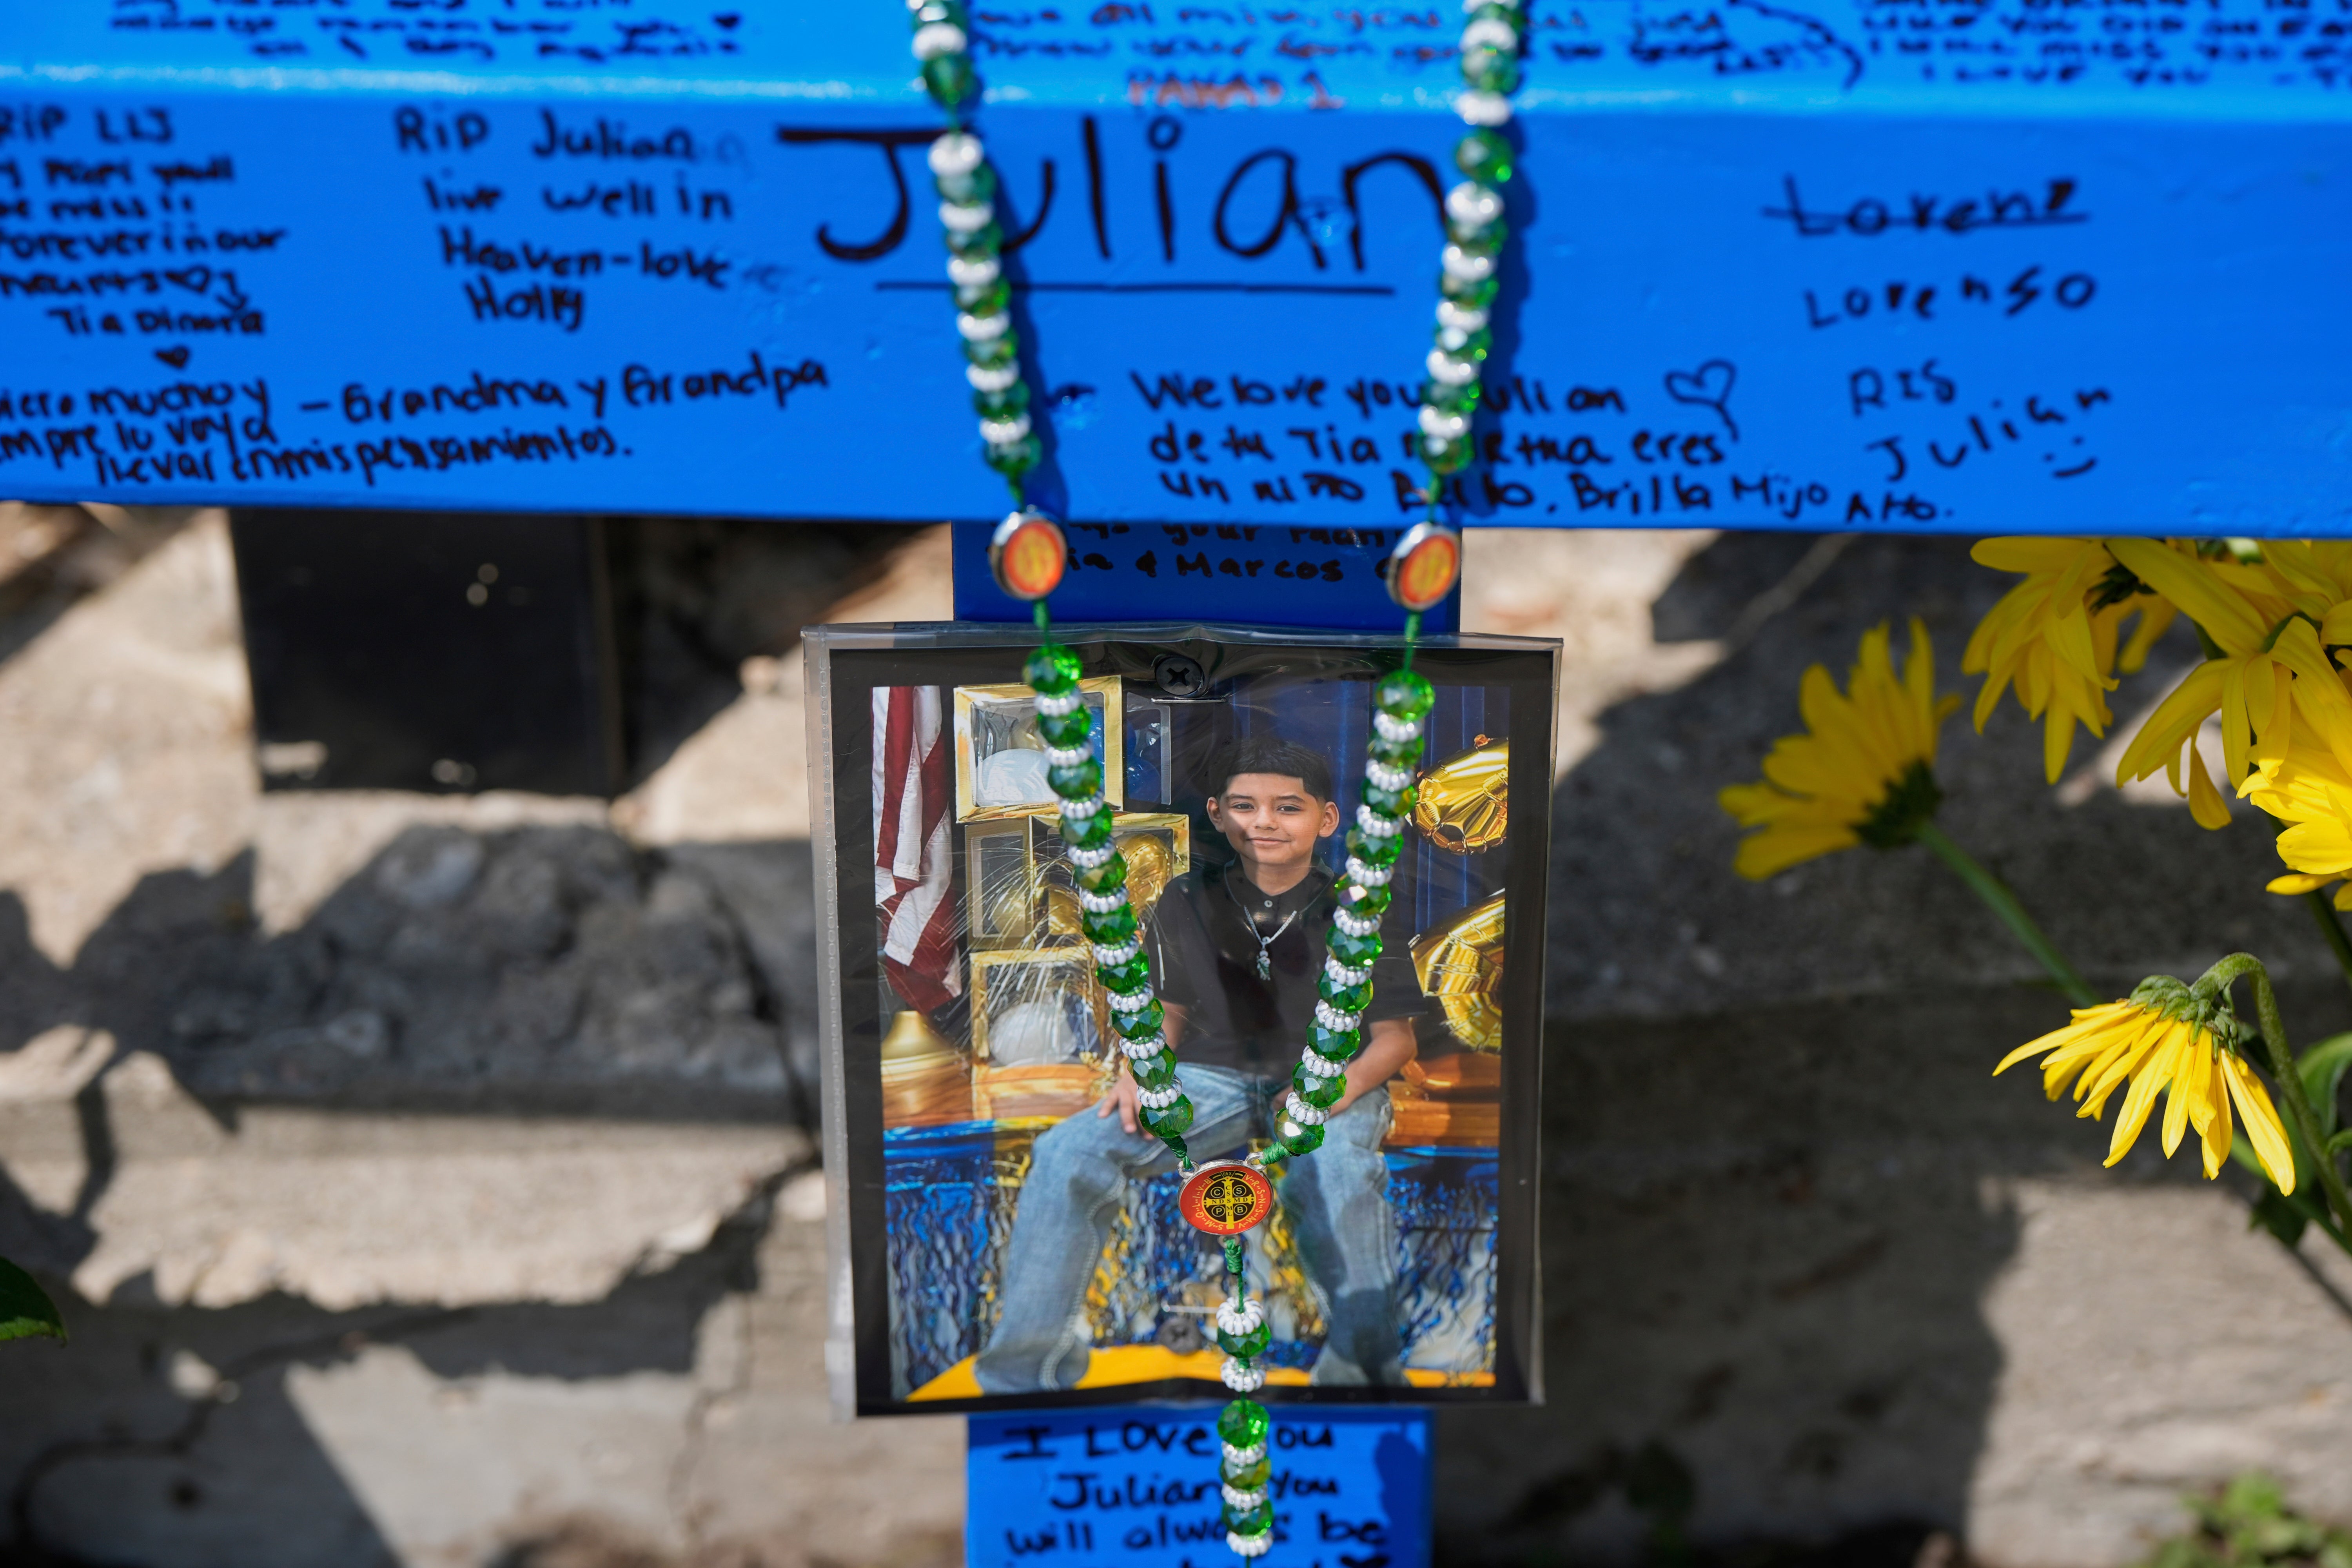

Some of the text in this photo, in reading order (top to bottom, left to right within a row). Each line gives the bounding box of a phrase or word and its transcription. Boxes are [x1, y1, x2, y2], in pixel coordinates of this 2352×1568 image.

[544, 183, 655, 218] well
[675, 169, 734, 220] in
[776, 116, 1448, 271] Julian
[342, 372, 569, 424] Grandma
[622, 350, 830, 412] Grandpa
[1480, 372, 1628, 416] ulian
[1630, 428, 1726, 466] eres
[1176, 551, 1345, 583] Marcos
[1004, 1521, 1096, 1557] will
[1315, 1510, 1390, 1546] be
